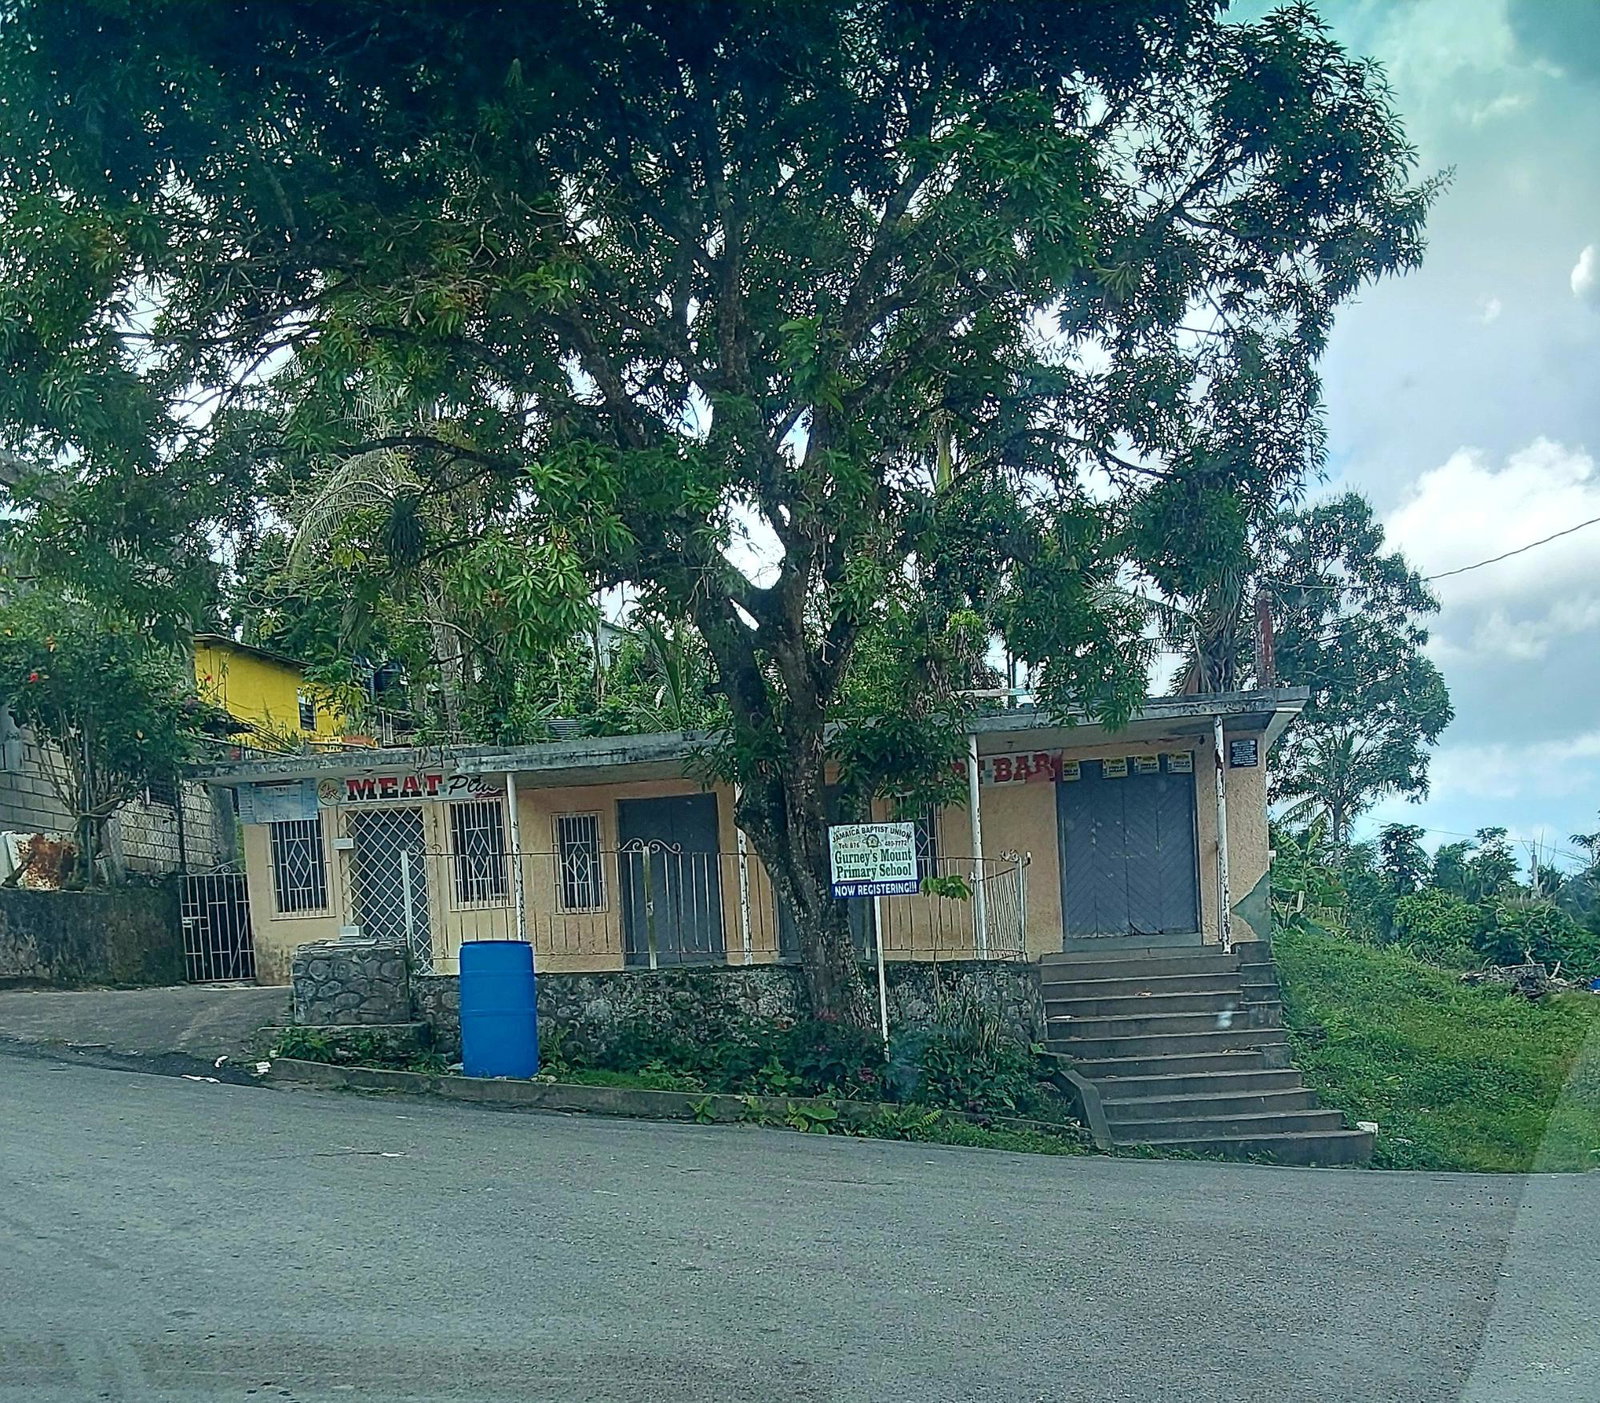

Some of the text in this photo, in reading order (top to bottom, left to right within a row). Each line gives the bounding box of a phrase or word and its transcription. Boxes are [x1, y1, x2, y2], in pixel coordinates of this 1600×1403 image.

[992, 753, 1055, 783] BAR
[346, 774, 443, 801] MEAT
[832, 825, 913, 843] JAMAICA BAPTIST UNION
[834, 848, 913, 866] Gurney's Mount
[836, 863, 912, 880] Primary School
[834, 881, 917, 897] NOW REGISTERING!!!
